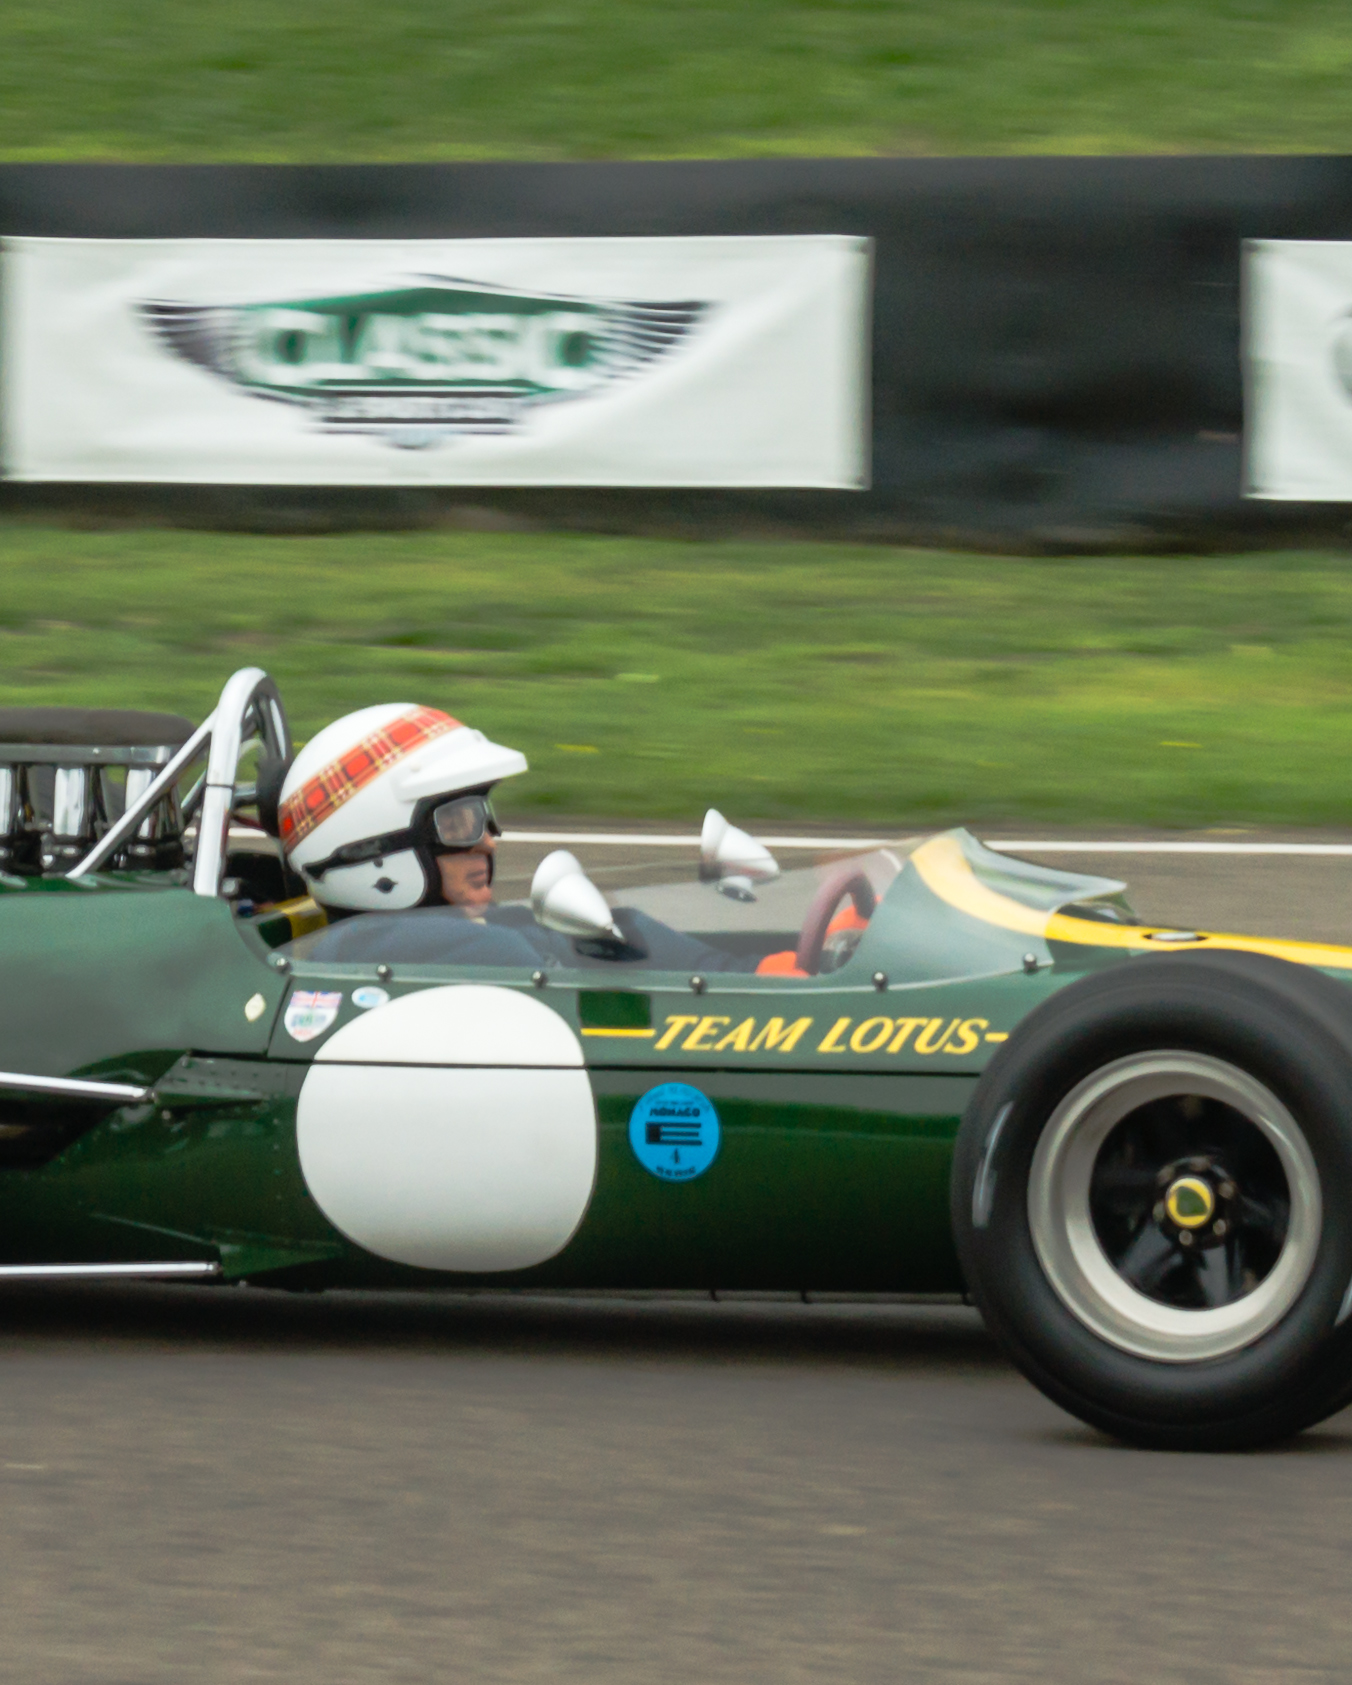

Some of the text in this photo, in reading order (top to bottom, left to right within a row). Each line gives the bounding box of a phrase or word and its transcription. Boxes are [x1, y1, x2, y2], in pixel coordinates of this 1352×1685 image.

[240, 308, 604, 390] CLASSIC
[654, 1015, 989, 1054] TEAM LOTUS
